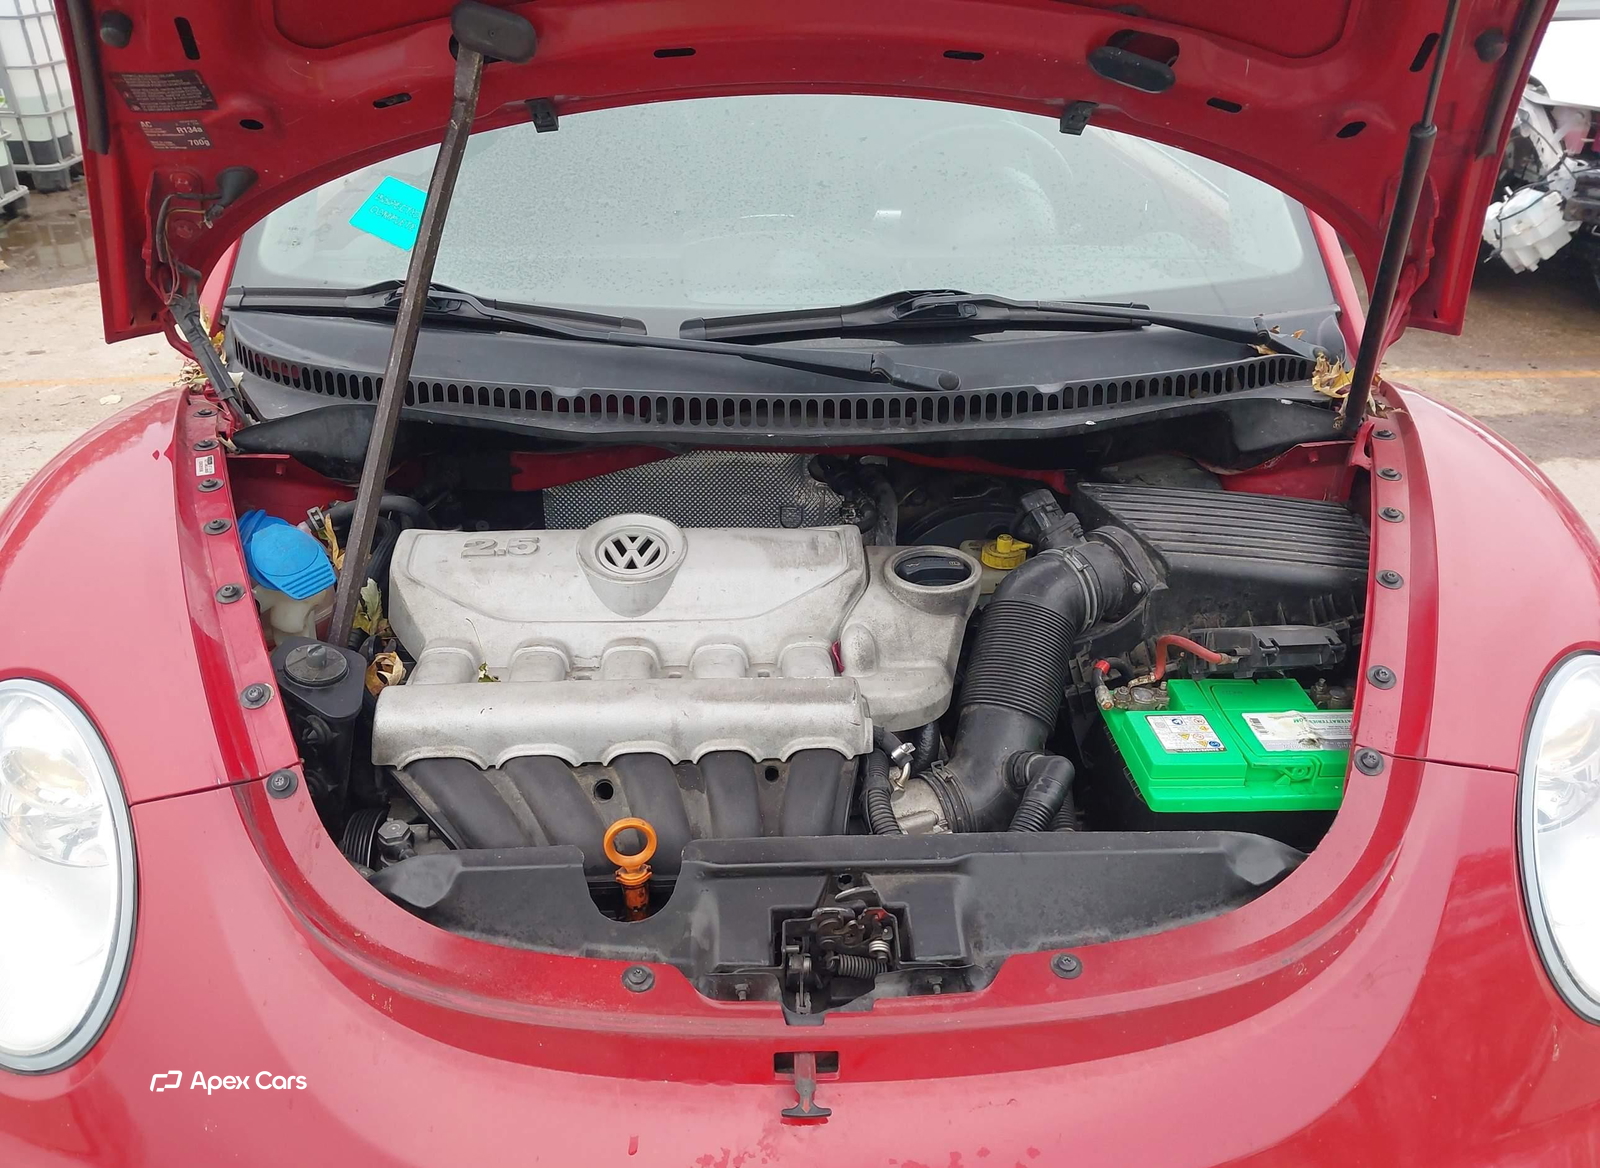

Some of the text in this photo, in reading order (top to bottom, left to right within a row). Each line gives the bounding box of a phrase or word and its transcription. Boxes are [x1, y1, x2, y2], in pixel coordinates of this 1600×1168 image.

[176, 126, 203, 134] R134a
[188, 139, 210, 147] 700g
[461, 536, 541, 559] 2.5
